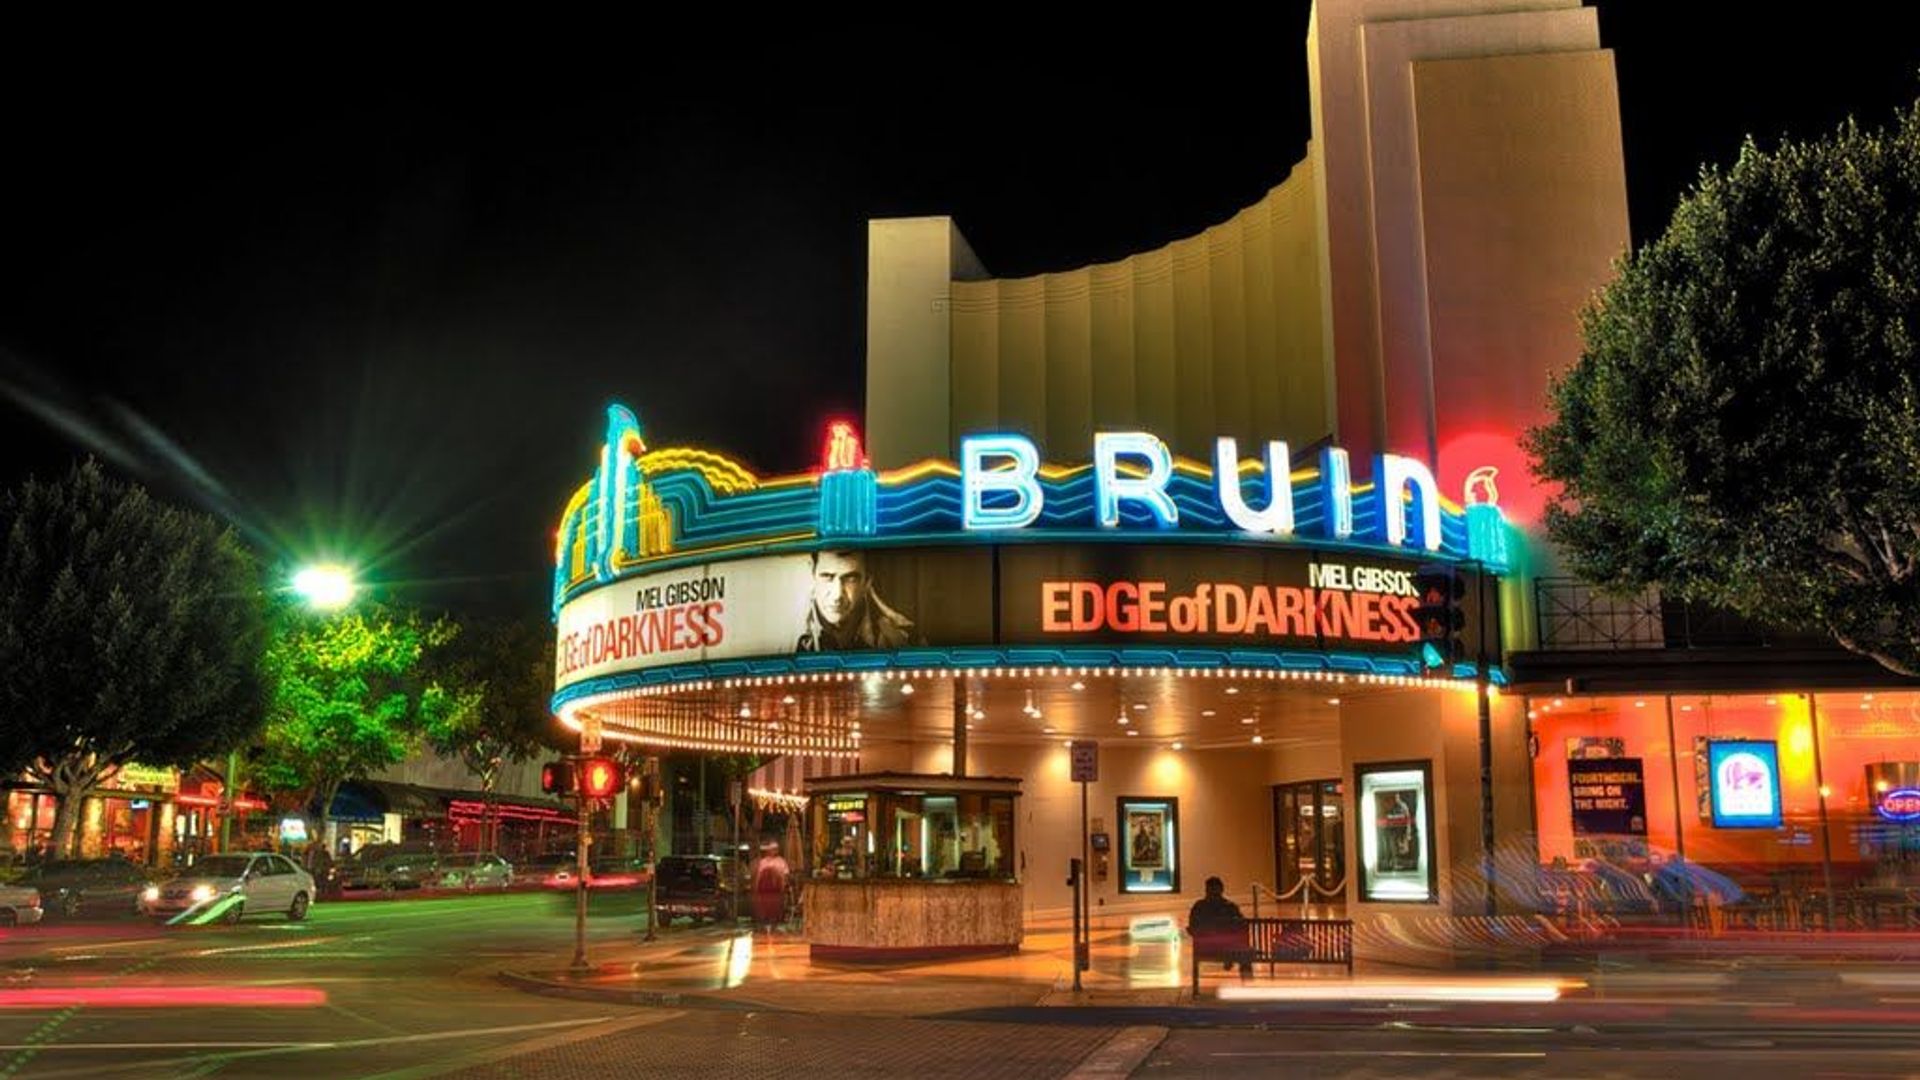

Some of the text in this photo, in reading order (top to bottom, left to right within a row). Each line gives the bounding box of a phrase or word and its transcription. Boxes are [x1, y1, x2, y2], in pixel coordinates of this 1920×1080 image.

[636, 576, 725, 612] MEL GIBSON
[1308, 563, 1353, 590] MEL
[1042, 582, 1421, 641] EDGE of DARKNESS
[592, 600, 724, 664] DARKNESS
[1606, 785, 1621, 796] ON
